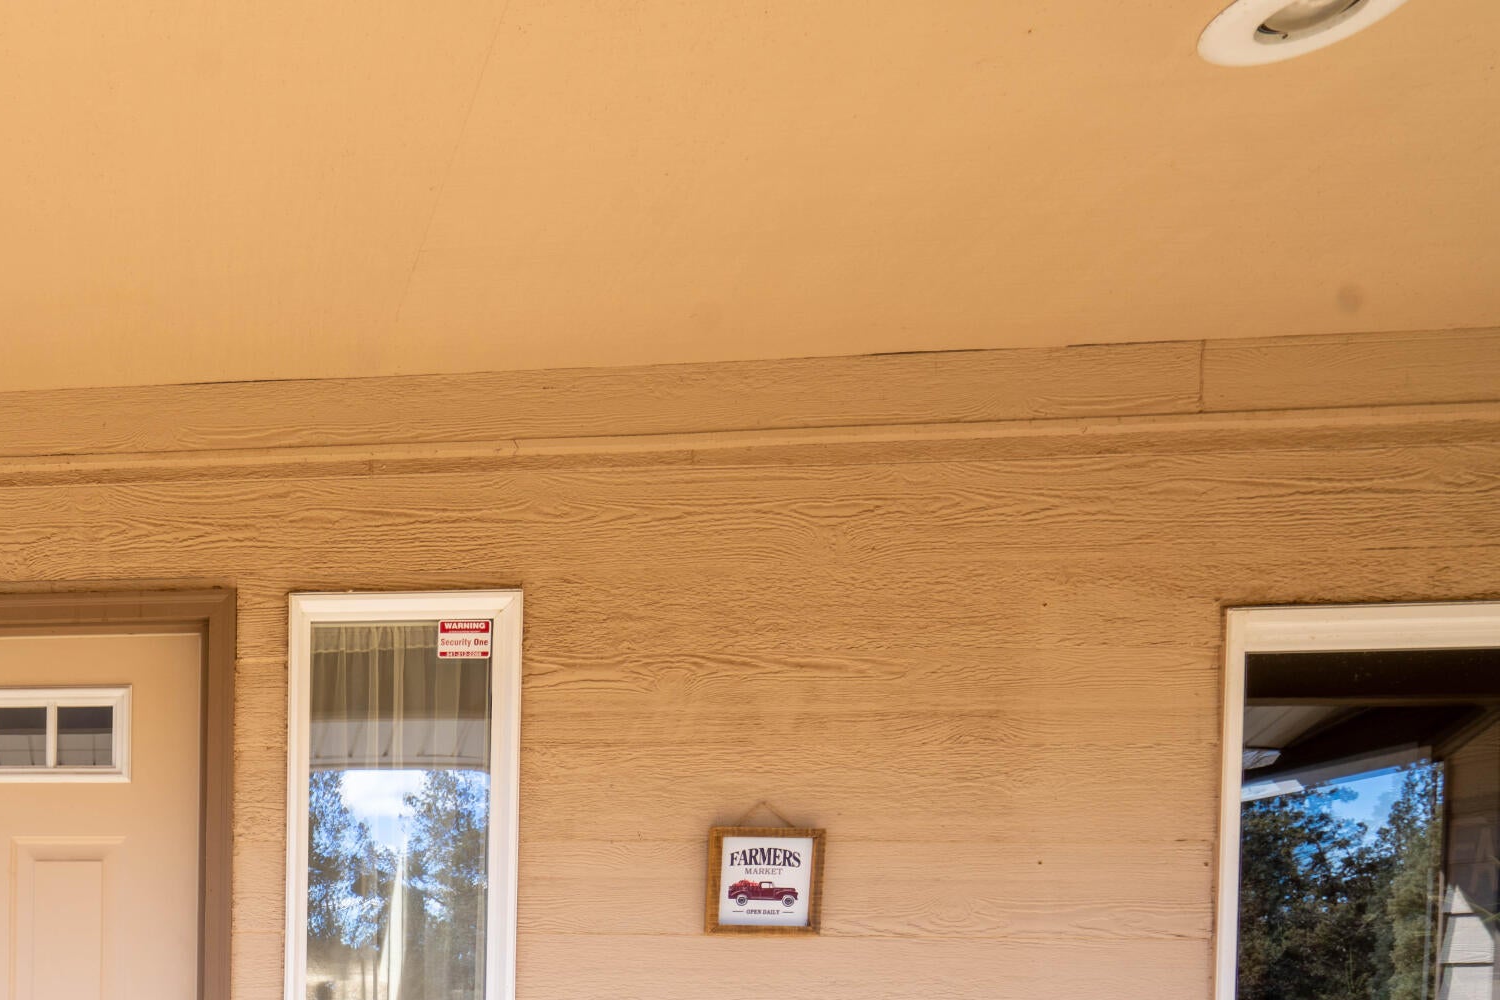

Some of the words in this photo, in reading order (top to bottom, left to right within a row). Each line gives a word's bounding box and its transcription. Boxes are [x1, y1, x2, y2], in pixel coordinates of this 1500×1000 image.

[444, 622, 486, 630] WARNING
[440, 638, 471, 647] Security
[473, 638, 489, 646] One
[729, 847, 801, 868] FARMERS
[744, 867, 783, 875] MARKET
